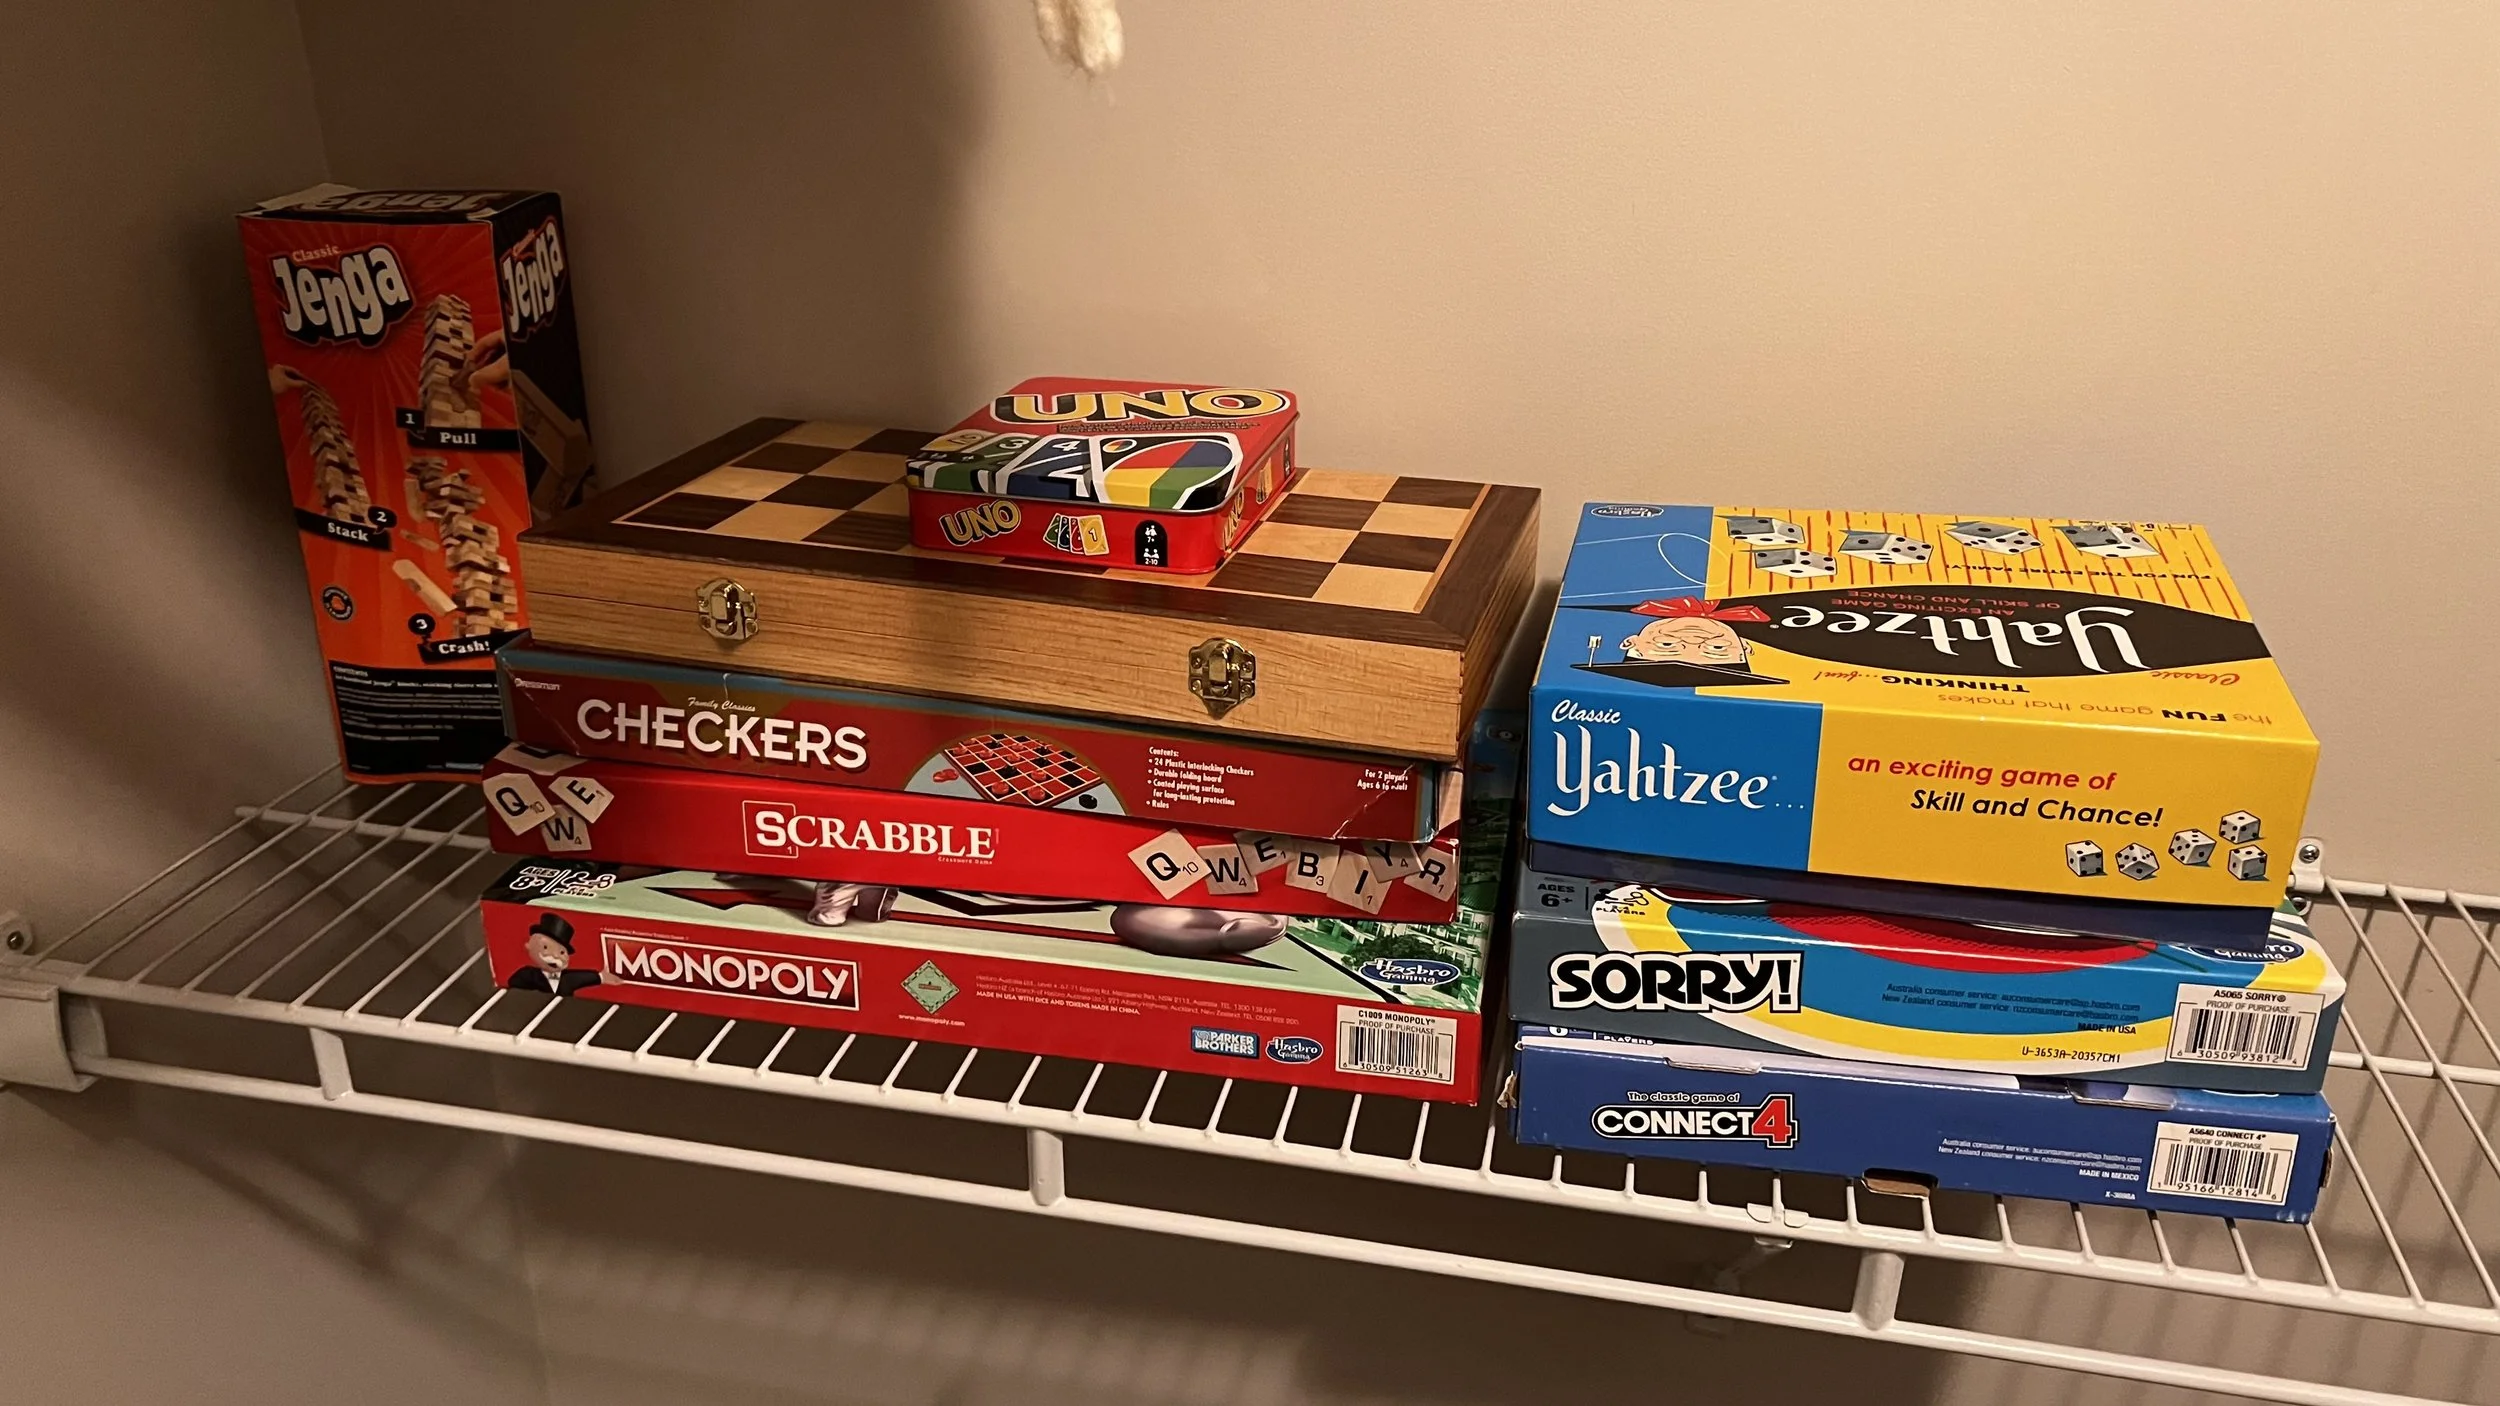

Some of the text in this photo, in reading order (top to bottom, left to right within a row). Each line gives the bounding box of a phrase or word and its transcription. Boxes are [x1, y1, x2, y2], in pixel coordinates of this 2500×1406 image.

[292, 244, 340, 262] Classic
[503, 222, 564, 334] Jenga
[272, 245, 410, 337] Jenga
[1000, 388, 1287, 423] UNO
[405, 414, 414, 425] 1
[440, 432, 477, 446] Pull
[1052, 441, 1080, 452] 4
[377, 512, 387, 523] 2
[940, 500, 1021, 545] UNO
[327, 522, 368, 543] Stack
[1088, 528, 1098, 542] 1
[1848, 590, 1926, 601] CHANCE
[1932, 595, 1970, 604] AND
[1831, 598, 2015, 616] AN EXCITING GAME
[1976, 599, 2029, 608] SKILL
[416, 619, 428, 630] 3
[438, 641, 490, 656] Crash!
[1882, 675, 2030, 693] THINKING
[2151, 670, 2240, 686] Classic
[688, 697, 755, 712] Family Classics
[1551, 699, 1621, 724] Classic
[1938, 693, 2272, 725] the FUN game that makes
[577, 699, 867, 768] CHECKERS
[1149, 747, 1179, 757] Contents:
[1154, 758, 1254, 776] 24 Plastic Interlocking Checkers
[1365, 769, 1376, 778] For
[1848, 756, 2119, 791] an exciting game of
[1153, 768, 1222, 783] Durable folding board
[566, 779, 596, 805] E
[1153, 779, 1225, 794] Coated playing surface
[1357, 779, 1390, 791] Ages to
[494, 787, 528, 817] Q
[1152, 800, 1170, 809] Rules
[1153, 789, 1236, 806] for long-lasting protection
[1910, 789, 2163, 828] Skill and Chance!
[544, 816, 574, 841] W
[756, 809, 996, 860] SCRABBLE
[1254, 837, 1278, 862] E
[1374, 843, 1409, 868] Y 4
[525, 867, 558, 877] AGES
[1146, 851, 1199, 881] Q 10
[1206, 857, 1247, 888] W 4
[1297, 852, 1324, 887] B 3
[1420, 857, 1447, 885] R
[1354, 870, 1368, 895] I
[1538, 884, 1575, 893] AGES
[1541, 893, 1573, 907] 6+
[615, 943, 849, 1001] MONOPOLY
[1375, 958, 1451, 977] Hasbro
[1380, 969, 1436, 984] Gaming
[1555, 957, 1795, 1007] SORRY!
[1887, 984, 1965, 997] Australia consumer
[2214, 989, 2243, 999] A5065
[976, 990, 994, 998] MADE
[995, 991, 1003, 999] IN
[1004, 993, 1017, 1001] USA
[1018, 994, 1035, 1003] WITH
[1035, 996, 1049, 1004] DICE
[1050, 998, 1065, 1006] AND
[1066, 1000, 1090, 1009] TOKENS
[1091, 1004, 1109, 1012] MADE
[1882, 993, 1977, 1009] New Zealand consumer
[2206, 1000, 2291, 1013] PROOF OF PURCHASE
[1358, 1010, 1382, 1019] C1009
[1359, 1020, 1382, 1028] PROOF
[1396, 1024, 1435, 1035] PURCHASE
[2078, 1022, 2104, 1032] MADE
[2118, 1026, 2136, 1034] USA
[1195, 1036, 1254, 1055] BROTHERS
[1210, 1031, 1254, 1045] PARKER
[1274, 1037, 1318, 1054] Hasbro
[2197, 1050, 2280, 1063] 30509 93812
[1360, 1063, 1427, 1077] 30509 51263
[1627, 1092, 1740, 1104] The classic game of
[1598, 1099, 1792, 1142] CONNECT 4
[2189, 1127, 2254, 1140] A5640 CONNECT
[1942, 1138, 2005, 1150] Australia consumer
[2189, 1137, 2212, 1145] PROOF
[2225, 1140, 2262, 1150] PURCHASE
[1938, 1146, 2013, 1160] New Zealand consumer
[2079, 1168, 2100, 1177] MADE
[2111, 1172, 2140, 1182] MEXICO
[2178, 1183, 2258, 1198] 95166 12814
